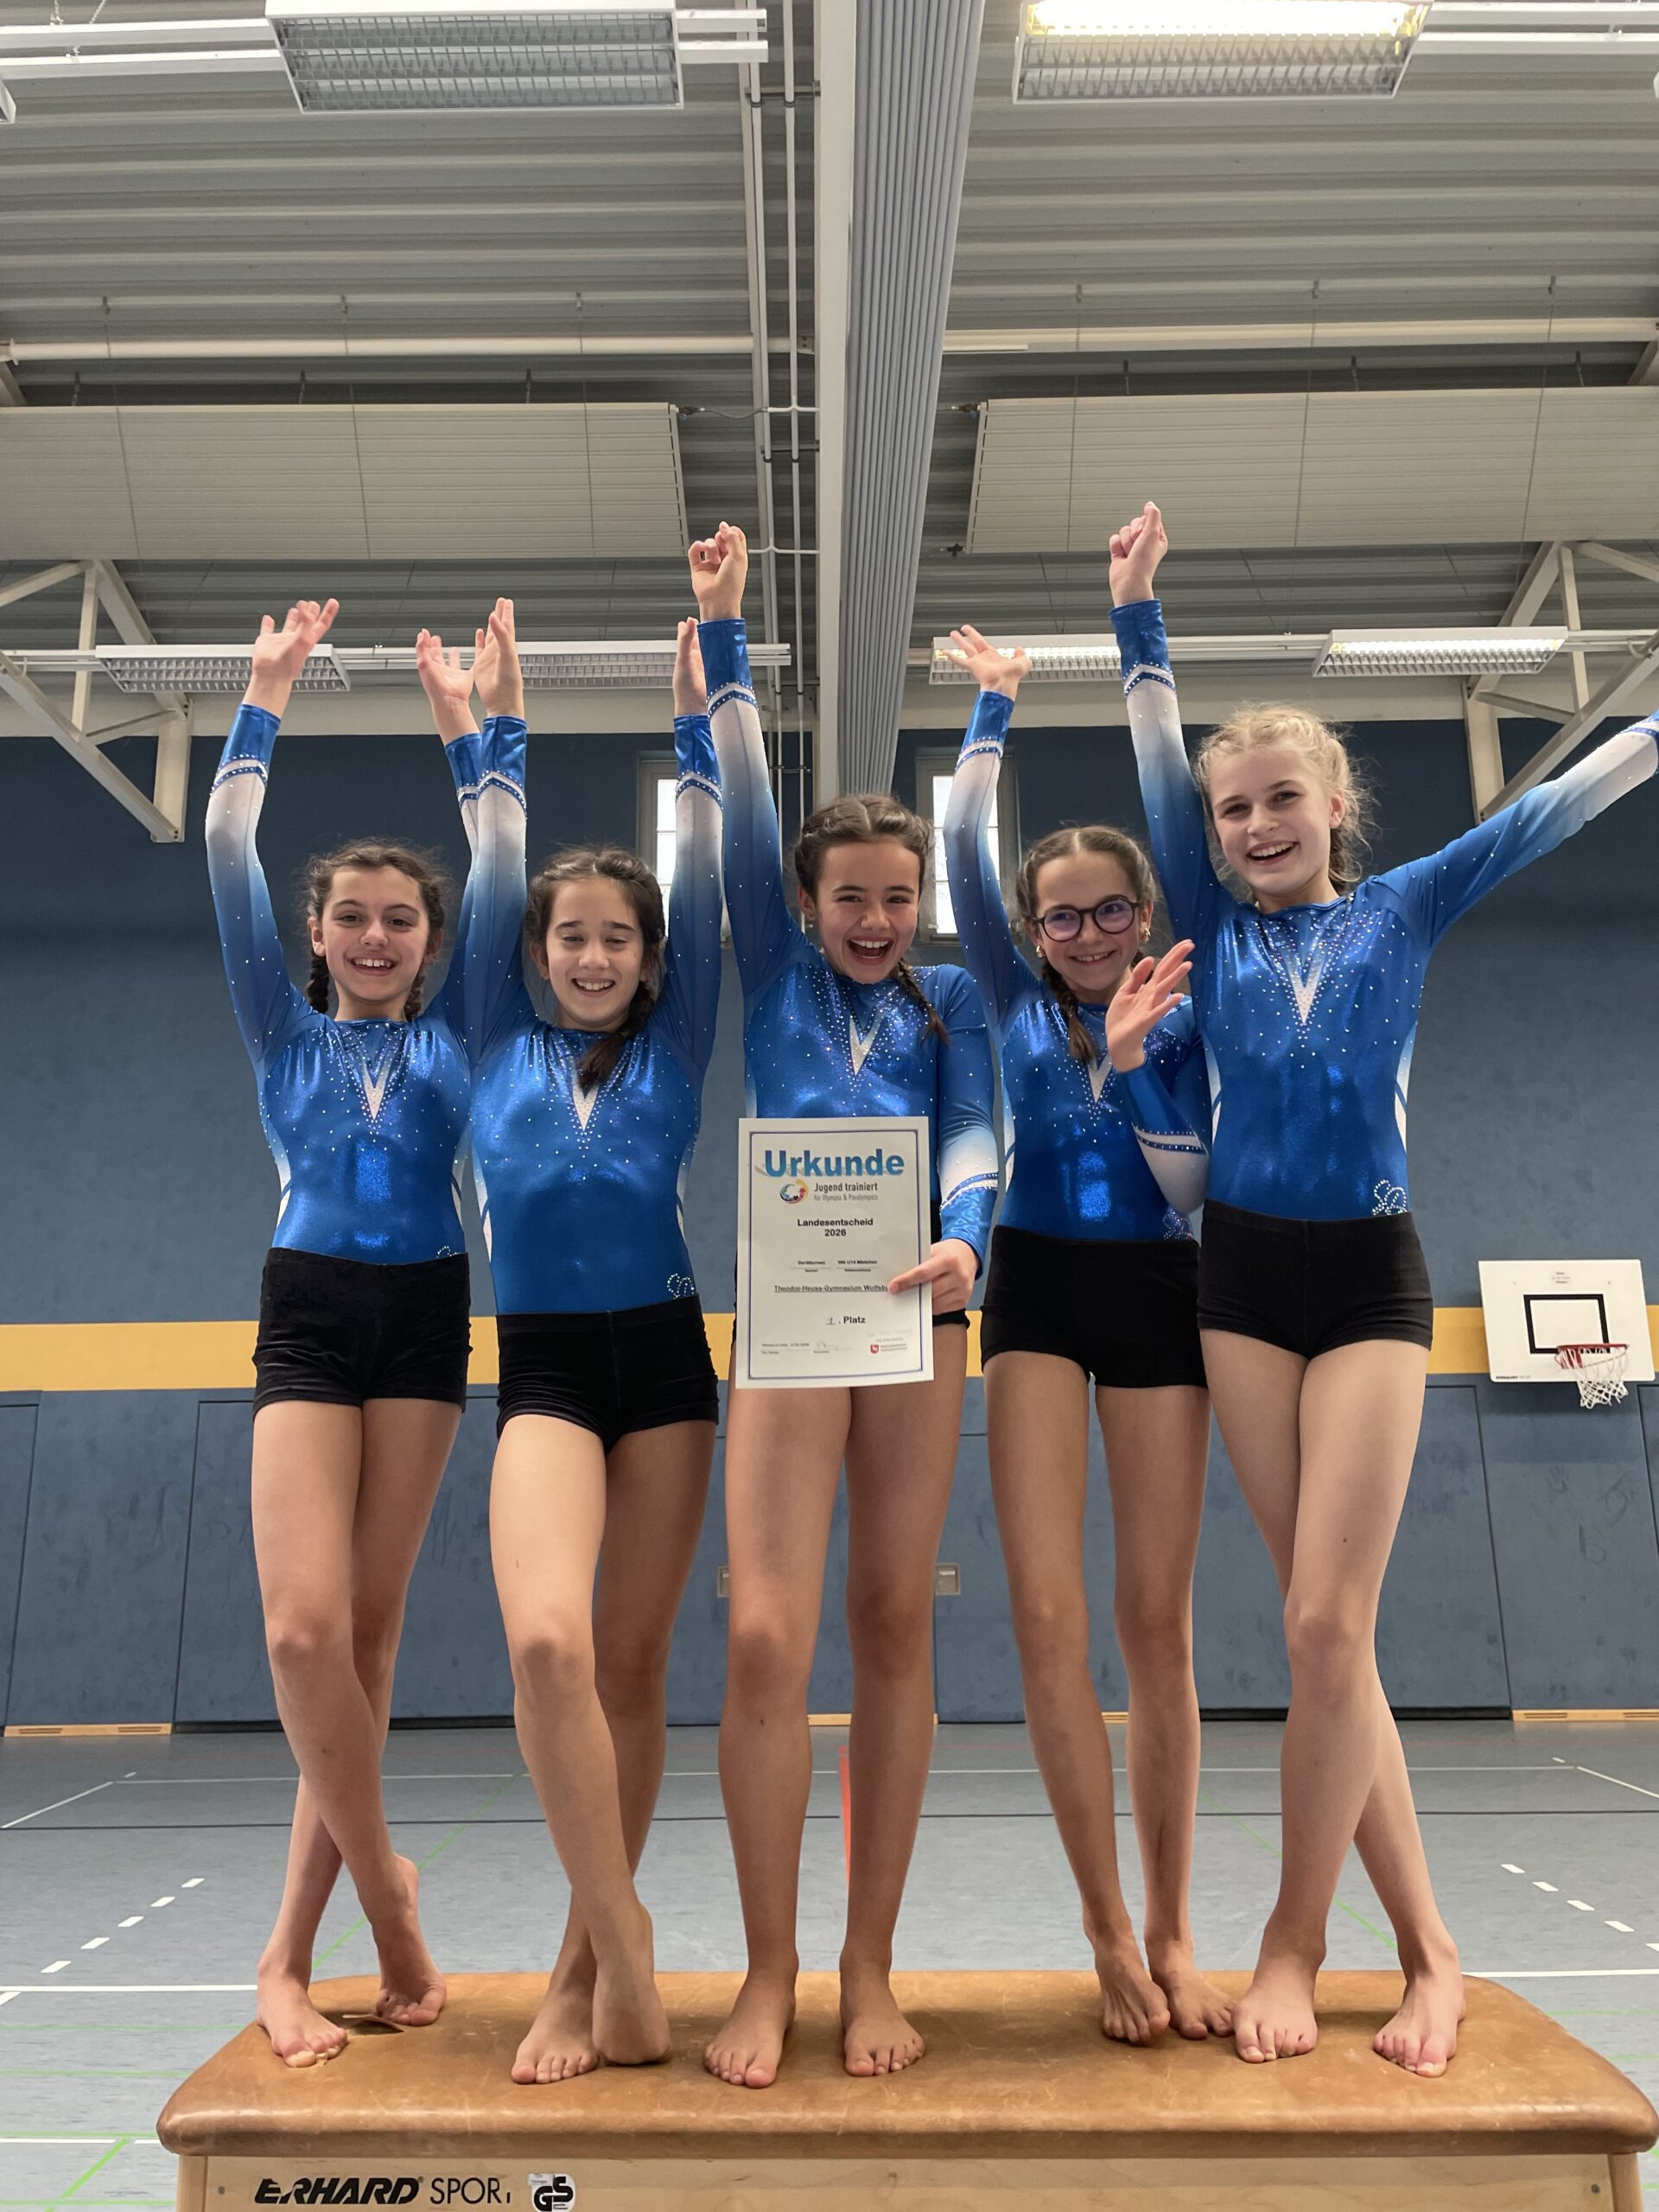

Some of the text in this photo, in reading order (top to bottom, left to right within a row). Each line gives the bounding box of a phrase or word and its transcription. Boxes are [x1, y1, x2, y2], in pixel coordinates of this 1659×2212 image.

[765, 1148, 905, 1178] Urkunde
[814, 1182, 878, 1193] Jugend trainiert
[797, 1218, 874, 1227] Landesentscheid
[843, 1315, 867, 1325] Platz
